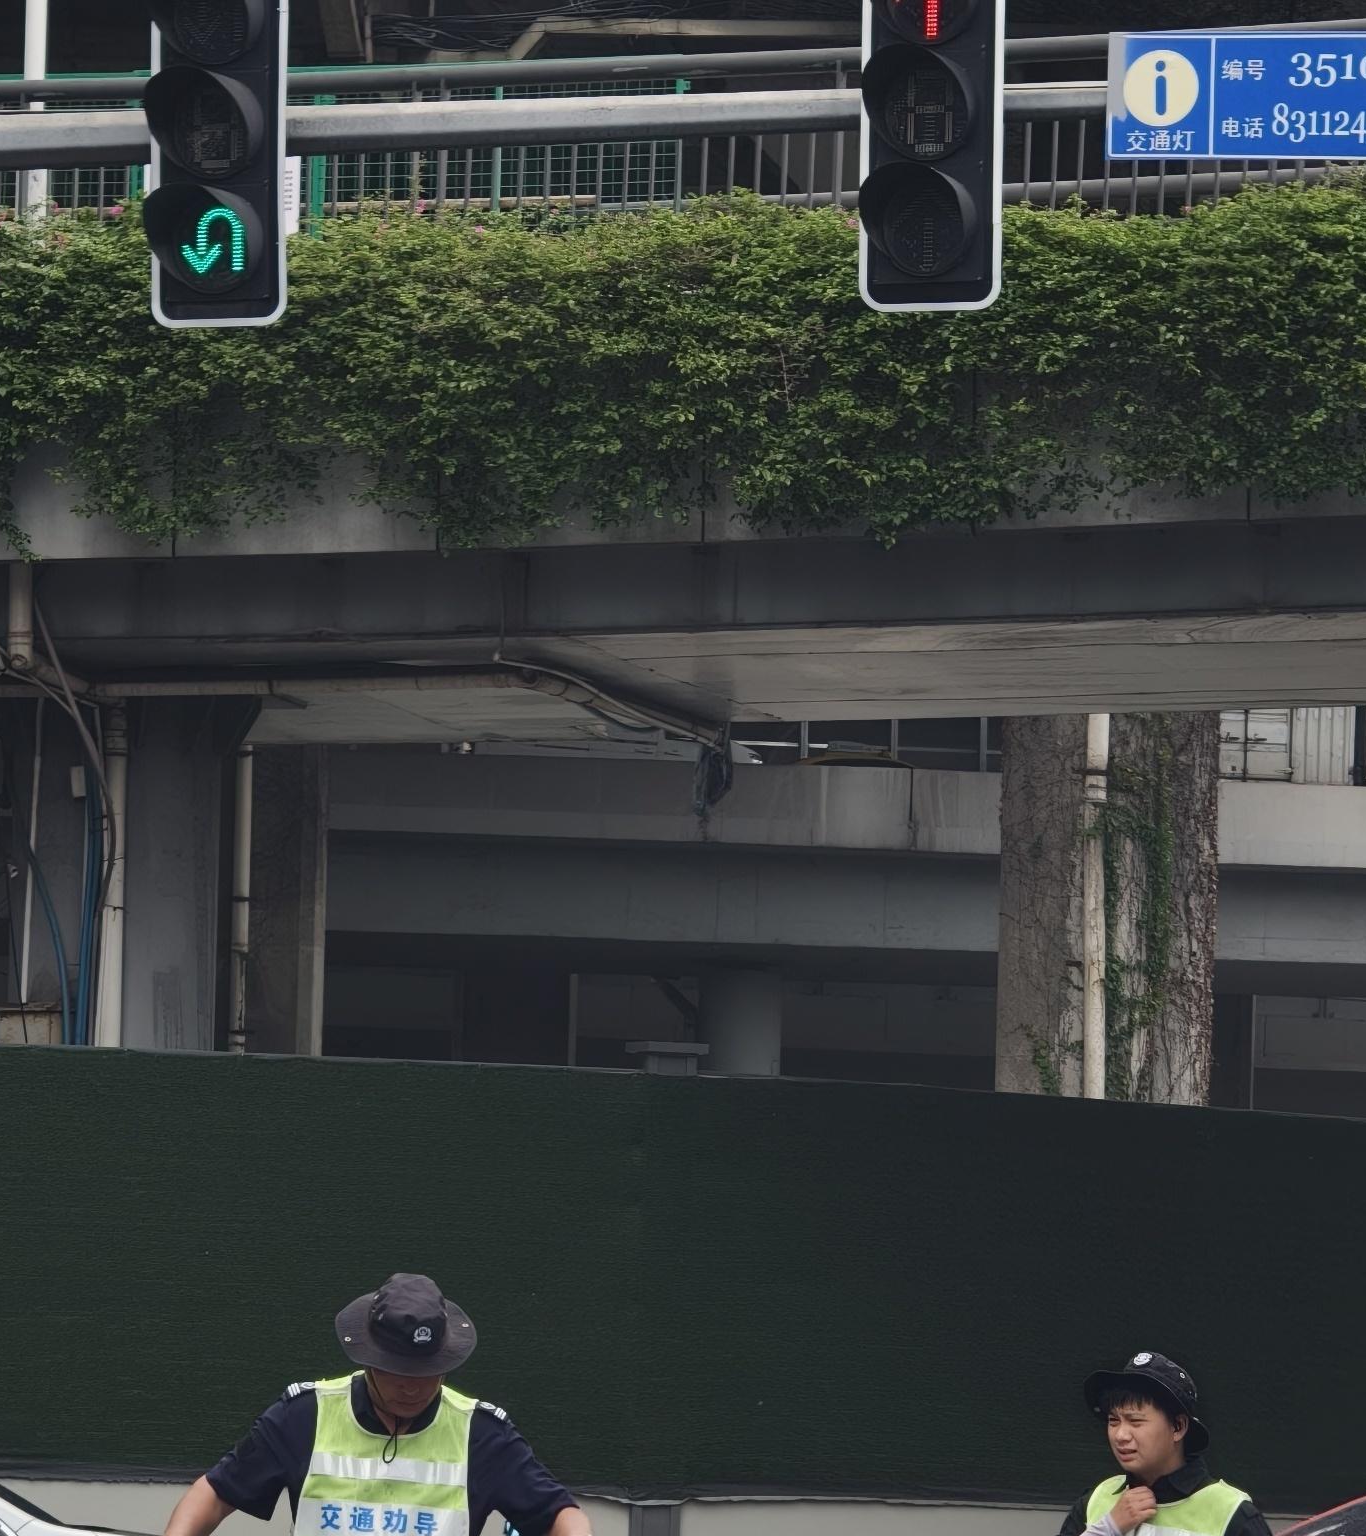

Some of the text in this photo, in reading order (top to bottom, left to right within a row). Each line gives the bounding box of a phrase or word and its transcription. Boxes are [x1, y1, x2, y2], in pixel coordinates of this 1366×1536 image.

[1221, 59, 1266, 81] 编号
[1221, 117, 1265, 139] 电话
[1126, 130, 1195, 152] 交通灯
